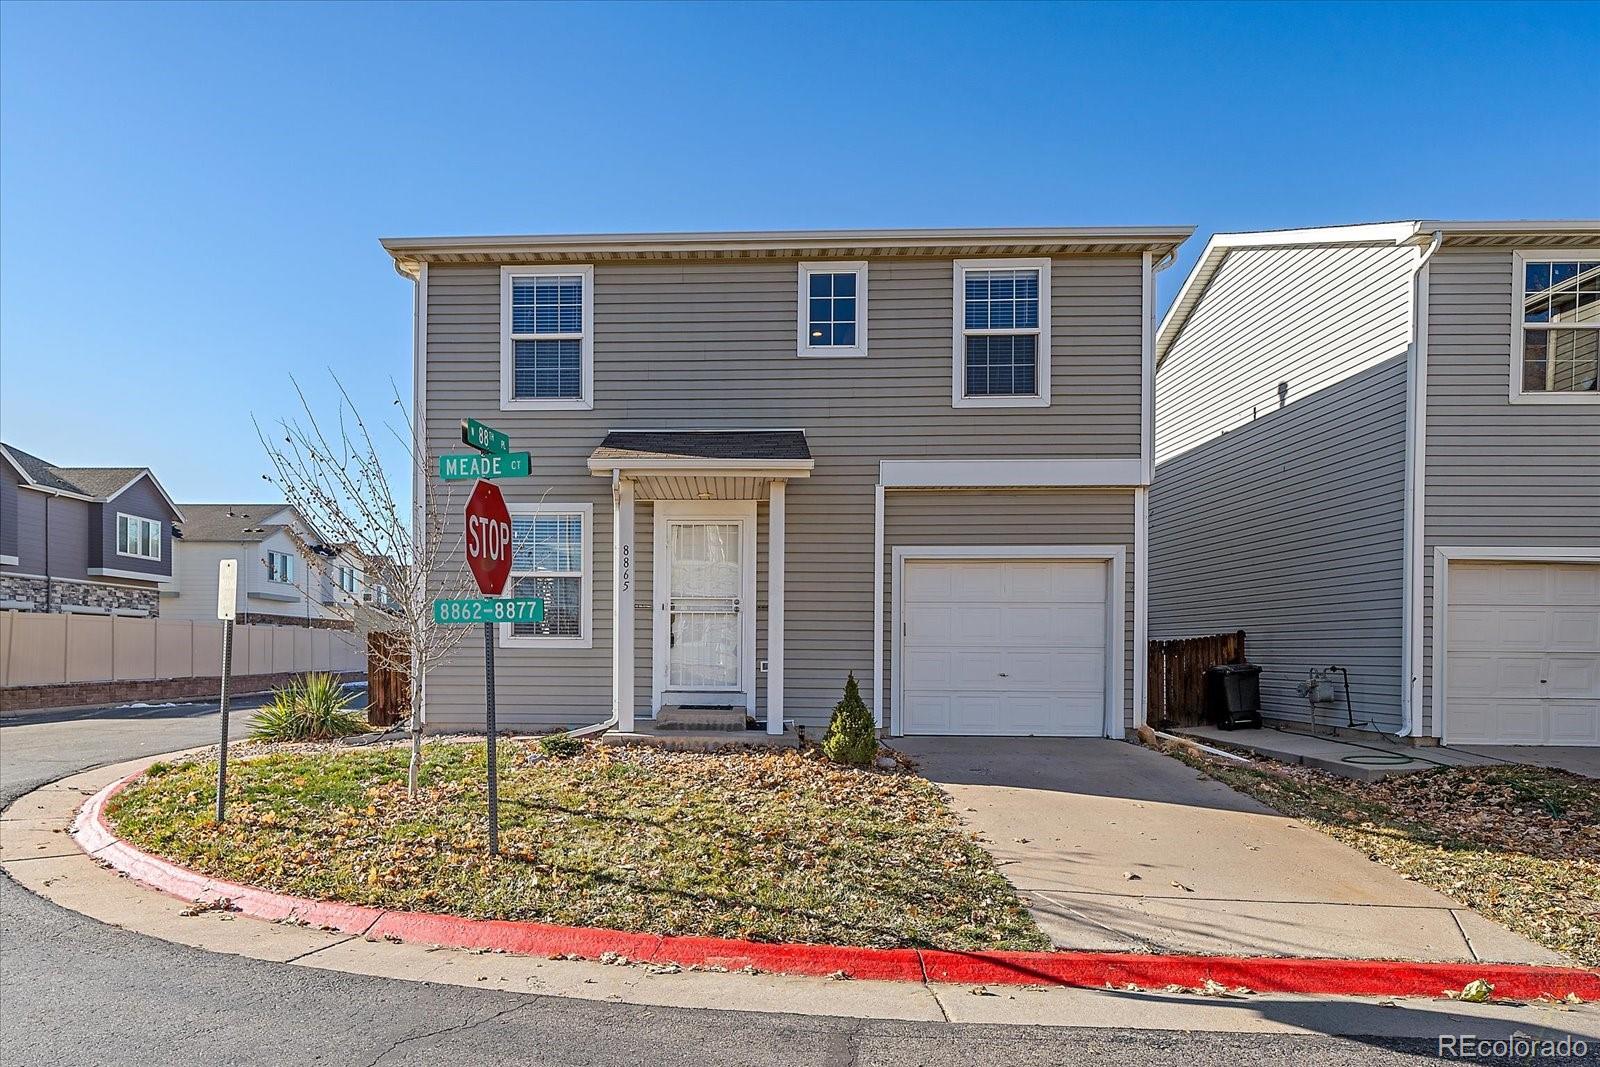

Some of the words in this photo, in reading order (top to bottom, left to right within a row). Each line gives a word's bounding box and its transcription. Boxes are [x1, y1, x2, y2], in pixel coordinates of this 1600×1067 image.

[446, 458, 502, 475] MEADE
[511, 460, 521, 470] CT
[469, 515, 510, 561] STOP
[622, 544, 630, 592] 8865
[440, 602, 537, 620] 8862-8877
